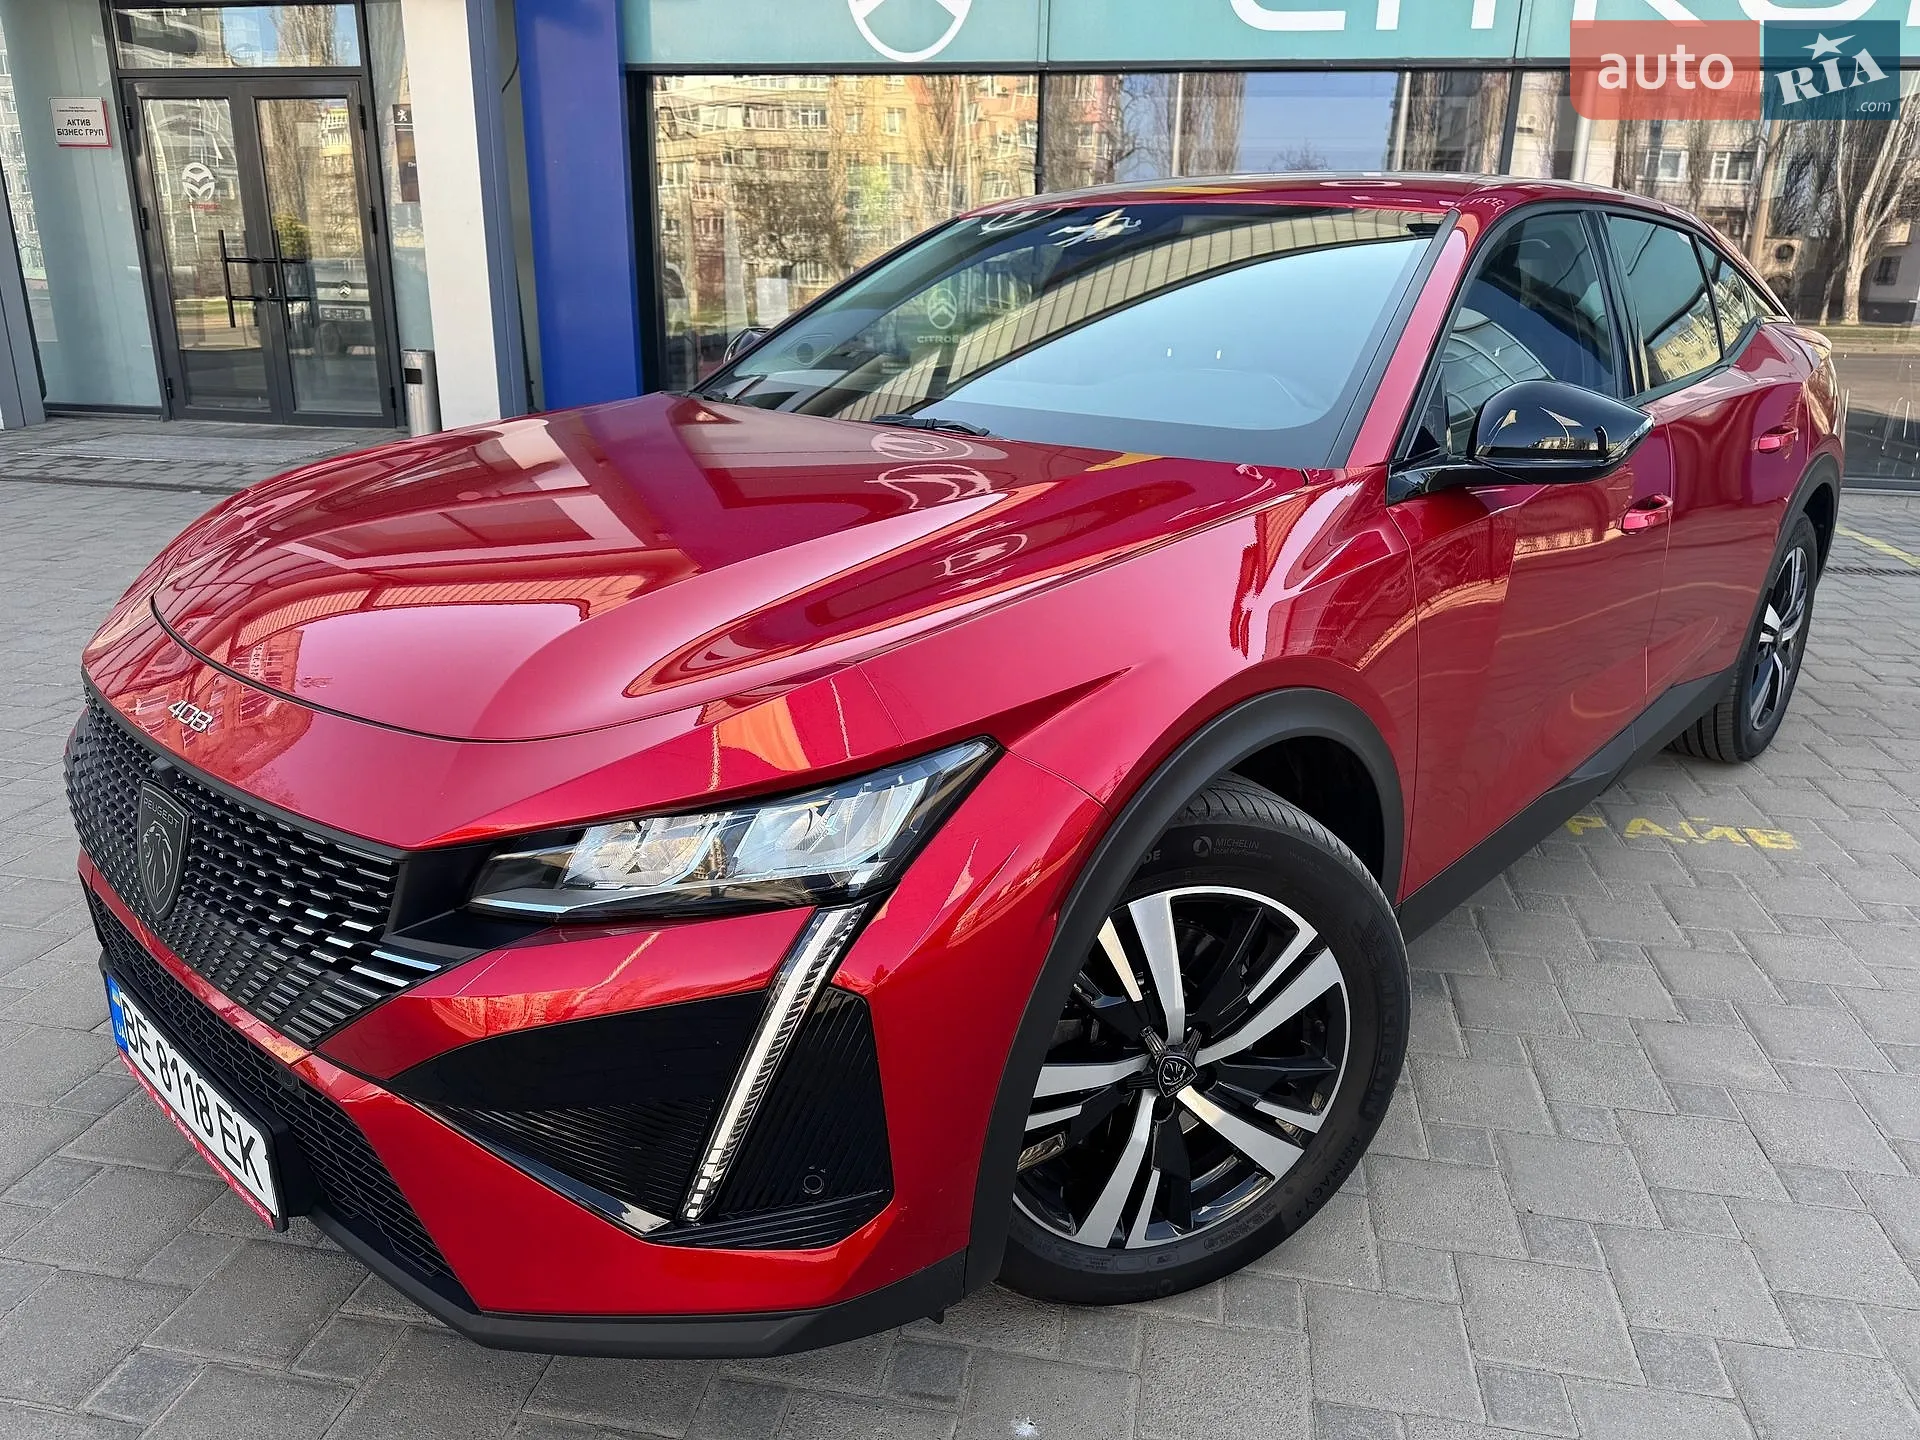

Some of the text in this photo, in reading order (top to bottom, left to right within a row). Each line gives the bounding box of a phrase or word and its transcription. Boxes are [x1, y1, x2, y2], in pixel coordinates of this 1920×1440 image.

[56, 128, 104, 136] БІЗНЕС ГРУП
[66, 119, 91, 127] АКТИВ
[167, 699, 214, 733] 408
[143, 797, 180, 829] PEUGEOT
[1215, 837, 1260, 849] MICHELIN
[115, 1020, 128, 1042] UA
[1365, 970, 1400, 1116] MICHELIN
[121, 996, 156, 1076] BE
[155, 1039, 214, 1138] 8118
[215, 1101, 265, 1193] EK
[1305, 1136, 1359, 1210] PRIMACY
